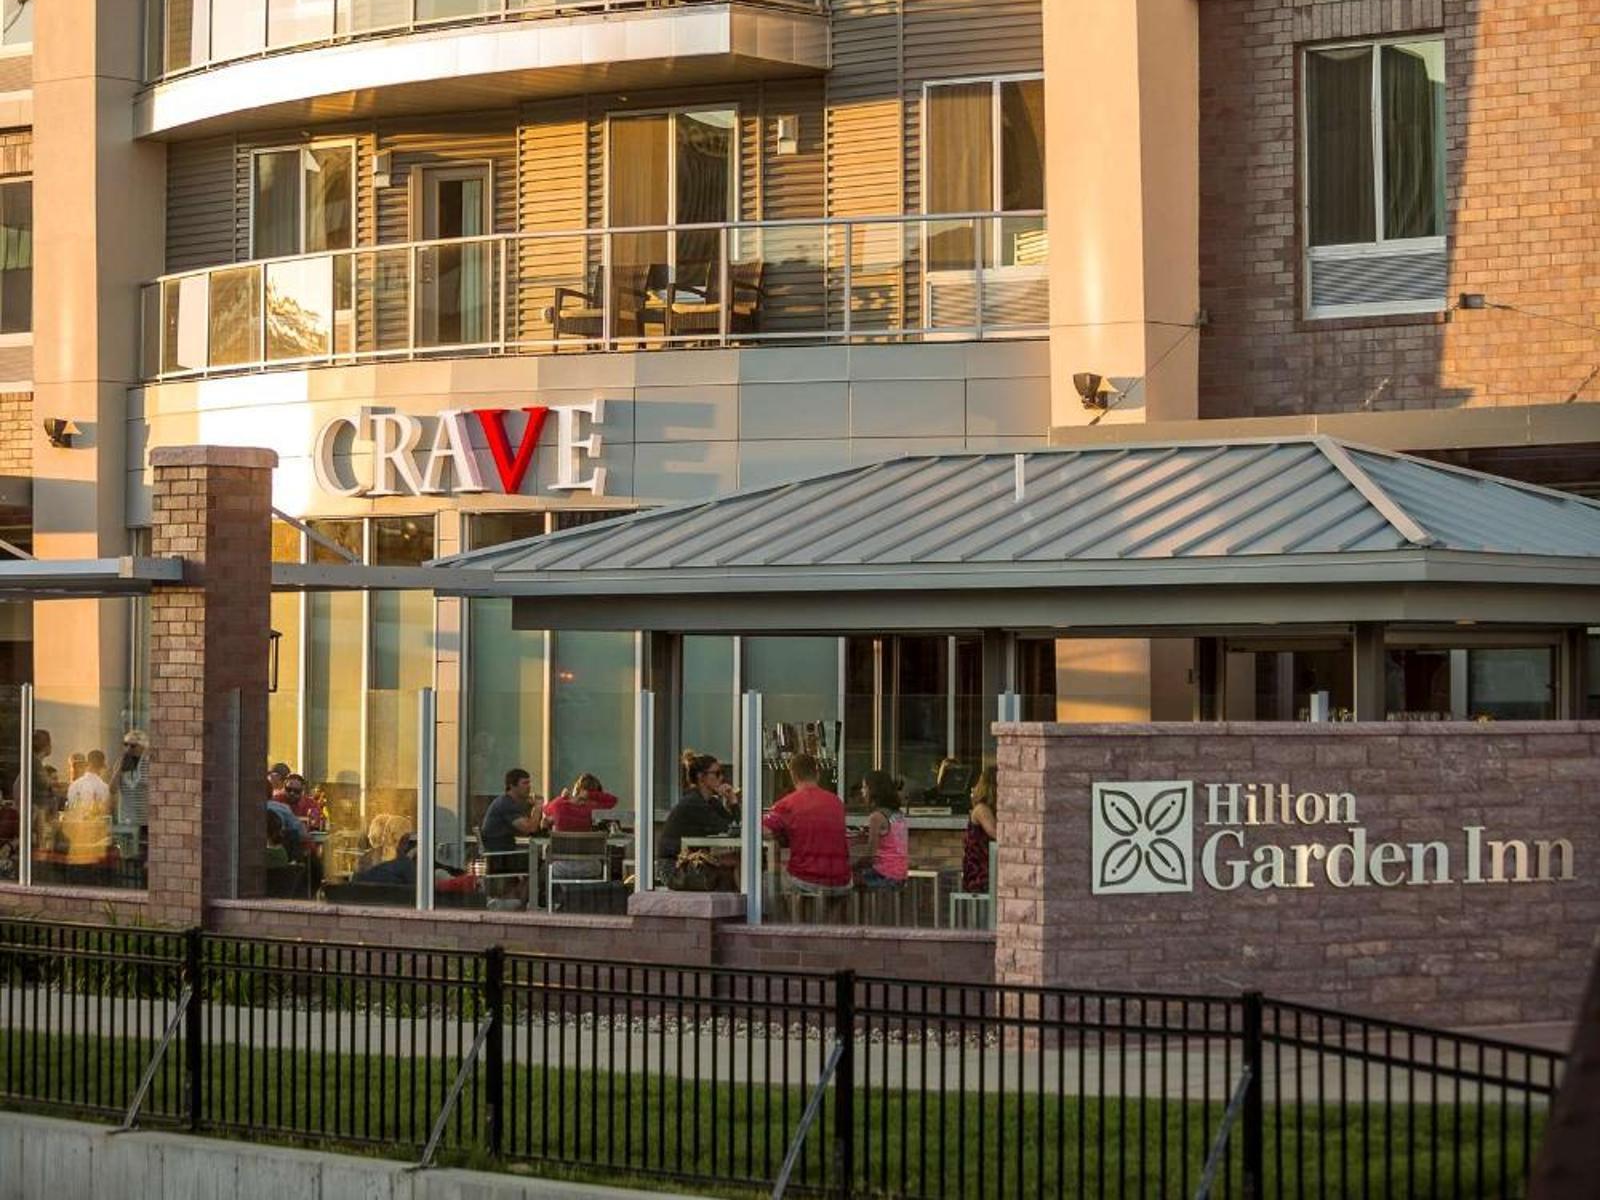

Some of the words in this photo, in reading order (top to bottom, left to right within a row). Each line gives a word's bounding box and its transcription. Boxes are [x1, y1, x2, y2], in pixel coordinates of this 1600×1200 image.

[313, 398, 607, 498] CRAVE
[1204, 782, 1360, 826] Hilton
[1200, 827, 1456, 891] Garden
[1461, 824, 1578, 885] Inn
